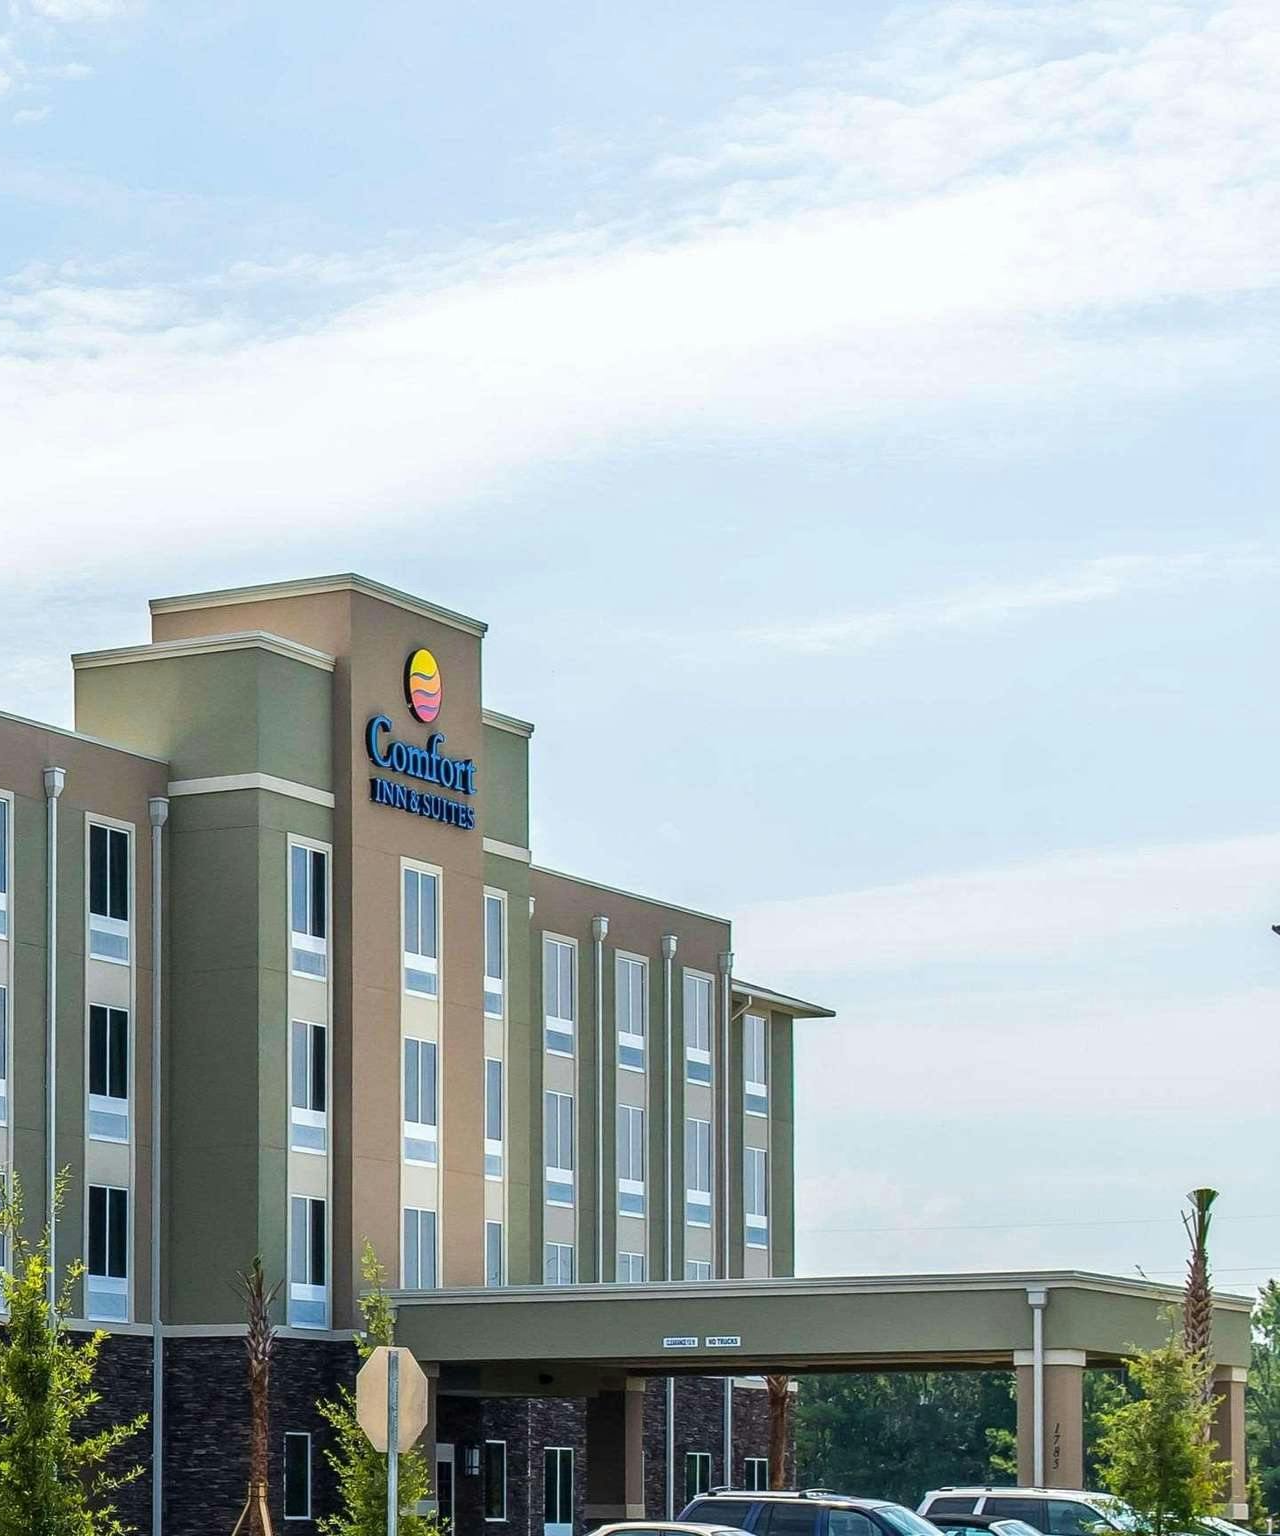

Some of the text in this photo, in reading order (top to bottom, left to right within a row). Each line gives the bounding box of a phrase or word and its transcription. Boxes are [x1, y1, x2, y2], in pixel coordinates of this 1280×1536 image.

[366, 714, 478, 795] Comfort
[708, 1337, 738, 1345] NO TRUCKS
[1053, 1422, 1061, 1470] 1785
